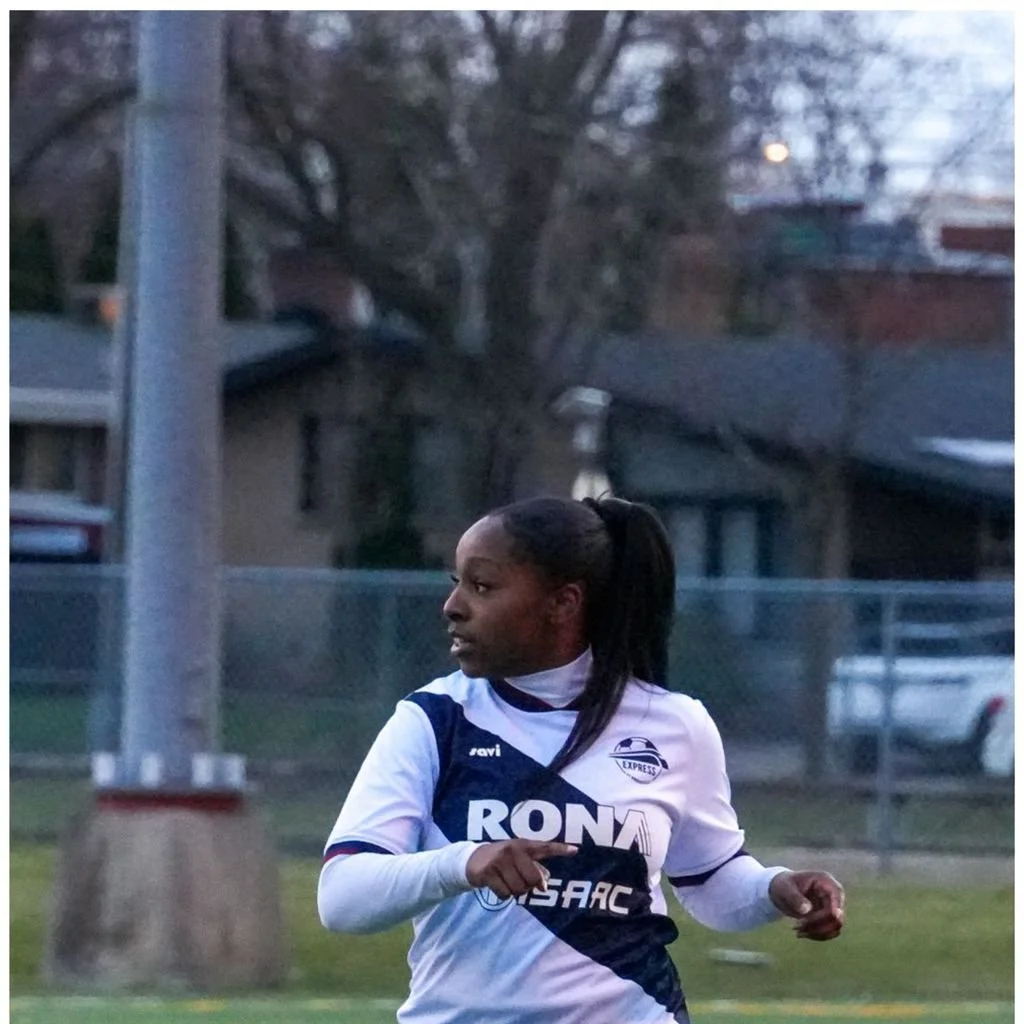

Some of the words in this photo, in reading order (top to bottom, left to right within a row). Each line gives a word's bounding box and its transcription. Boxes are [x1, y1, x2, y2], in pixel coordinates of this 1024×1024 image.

[469, 743, 501, 757] savi
[622, 760, 657, 777] EXPRESS
[467, 799, 652, 857] RONA
